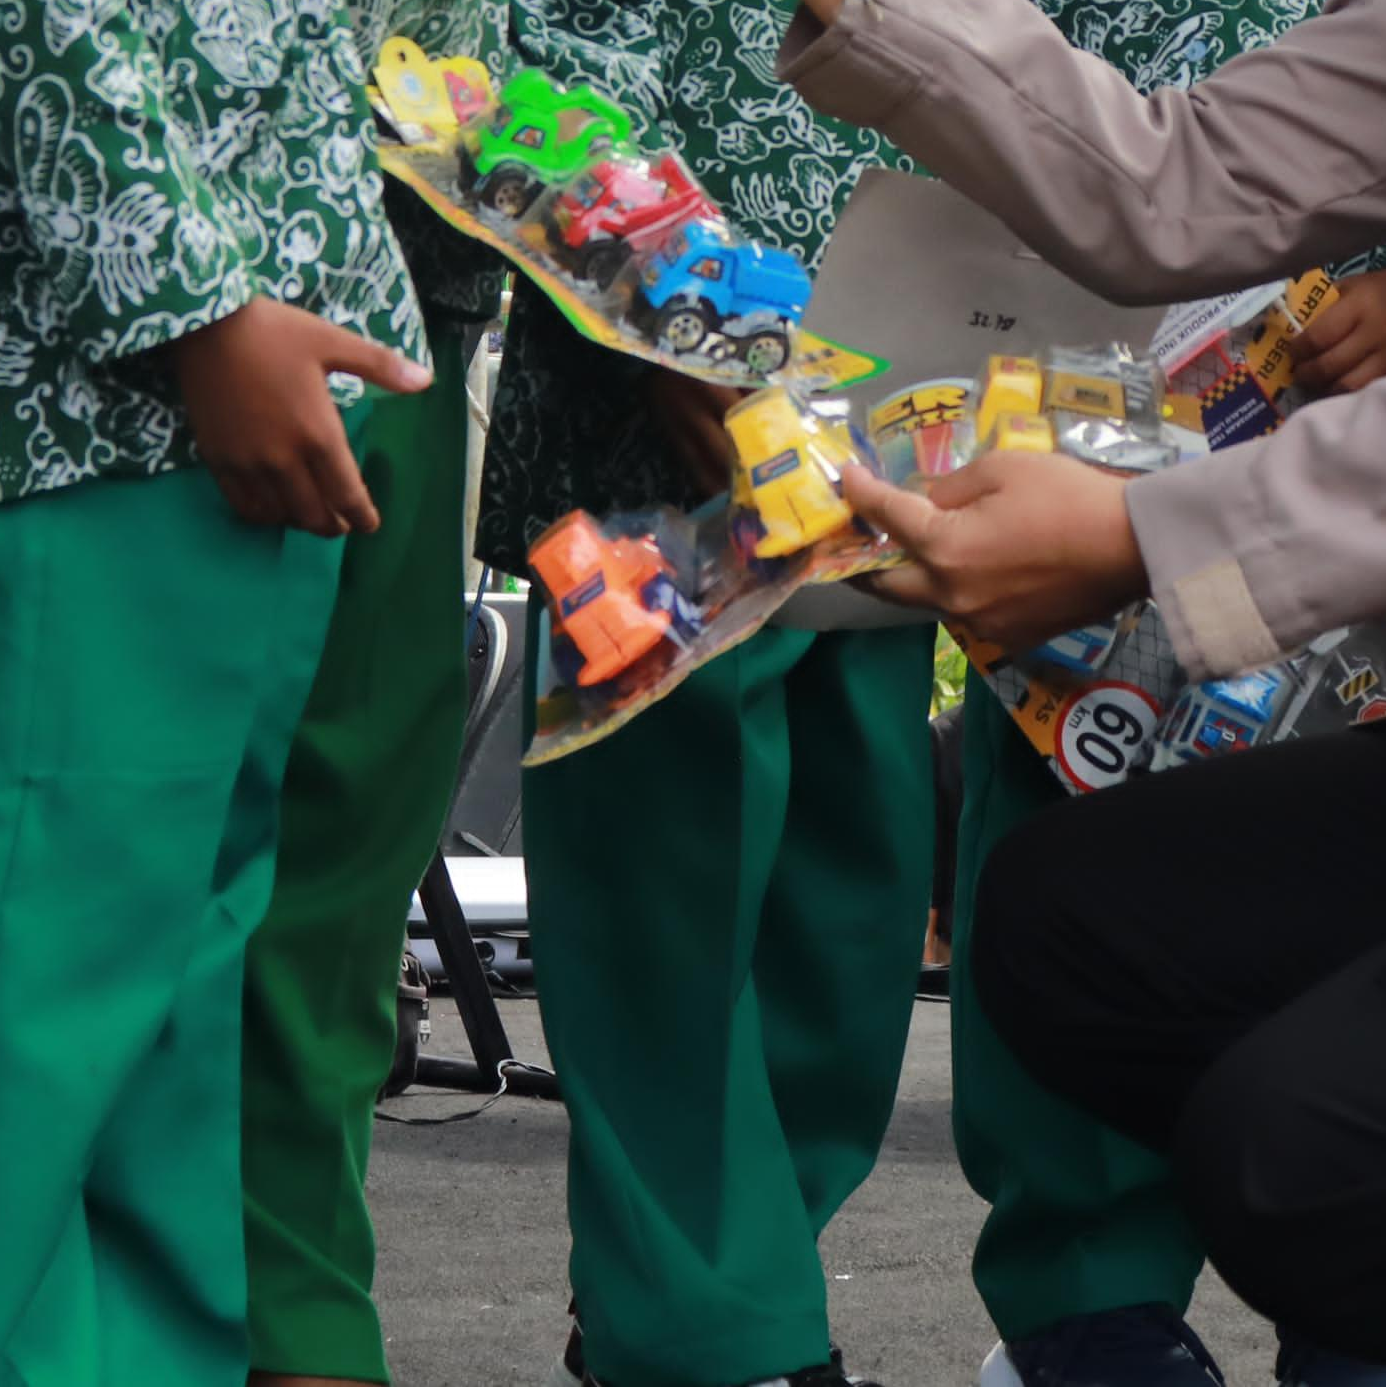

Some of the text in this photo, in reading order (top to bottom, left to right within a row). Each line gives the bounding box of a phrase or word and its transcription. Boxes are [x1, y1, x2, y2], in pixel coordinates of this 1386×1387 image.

[1179, 305, 1222, 342] PRODUK
[1068, 705, 1092, 730] km
[1075, 702, 1144, 774] 60
